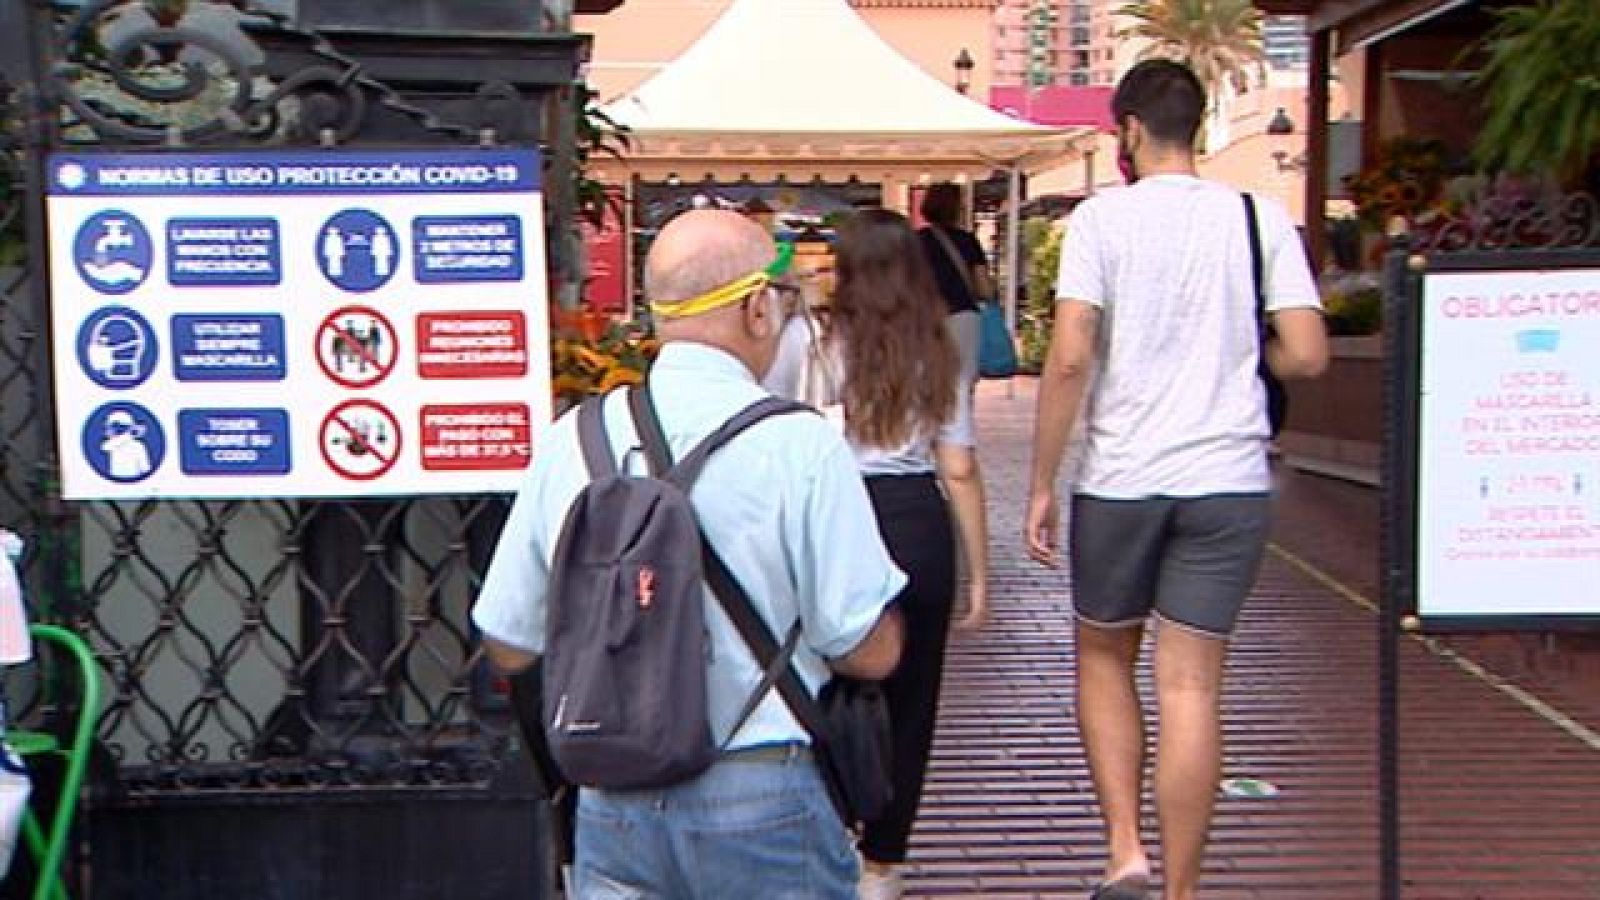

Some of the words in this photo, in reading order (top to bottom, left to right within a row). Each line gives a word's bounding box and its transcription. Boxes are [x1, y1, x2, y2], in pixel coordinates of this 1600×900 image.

[98, 167, 188, 186] NORMAS
[192, 166, 225, 186] DE
[226, 166, 273, 186] USO
[278, 162, 421, 186] PROTECCIÓN
[424, 165, 518, 184] COVID-19
